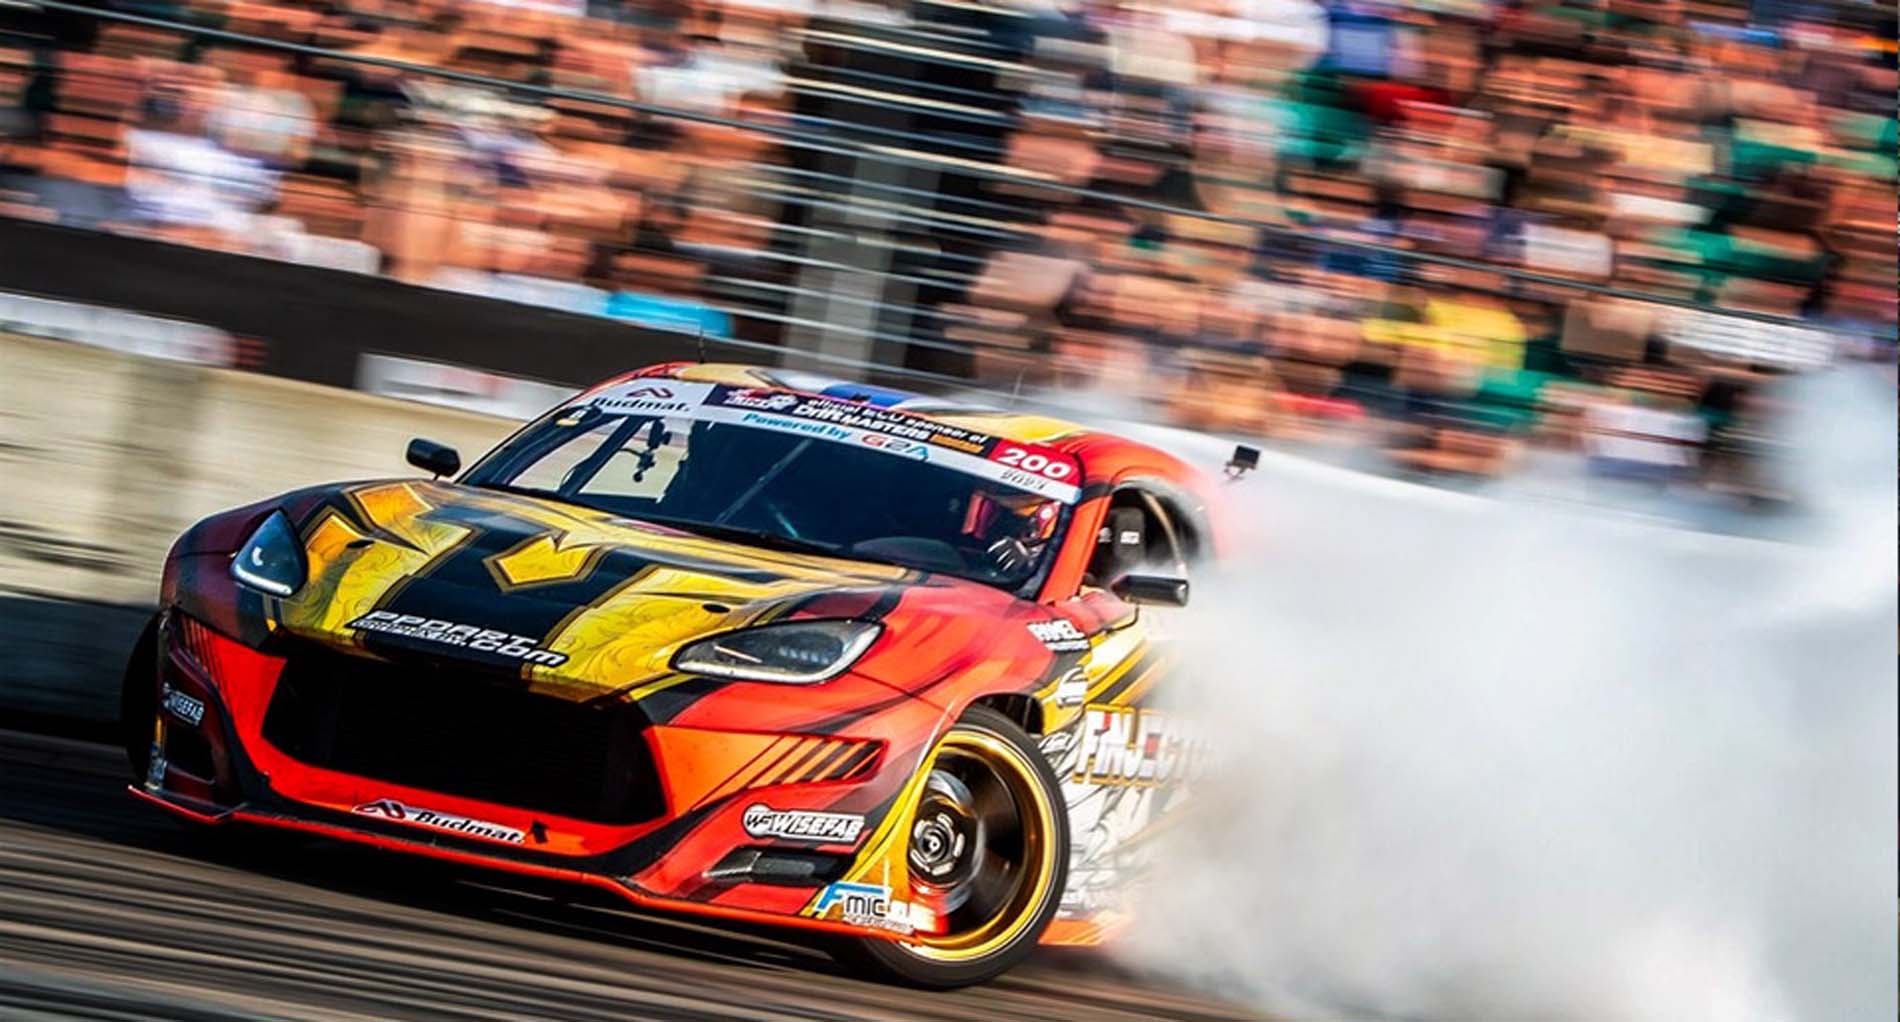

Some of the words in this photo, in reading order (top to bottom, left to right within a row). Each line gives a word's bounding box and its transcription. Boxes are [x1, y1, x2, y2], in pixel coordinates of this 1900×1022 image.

[743, 412, 829, 432] Powered
[827, 426, 851, 440] by
[903, 418, 970, 439] sponsor
[861, 433, 930, 461] G2A
[997, 447, 1071, 479] 200
[772, 812, 865, 841] WISEFAB
